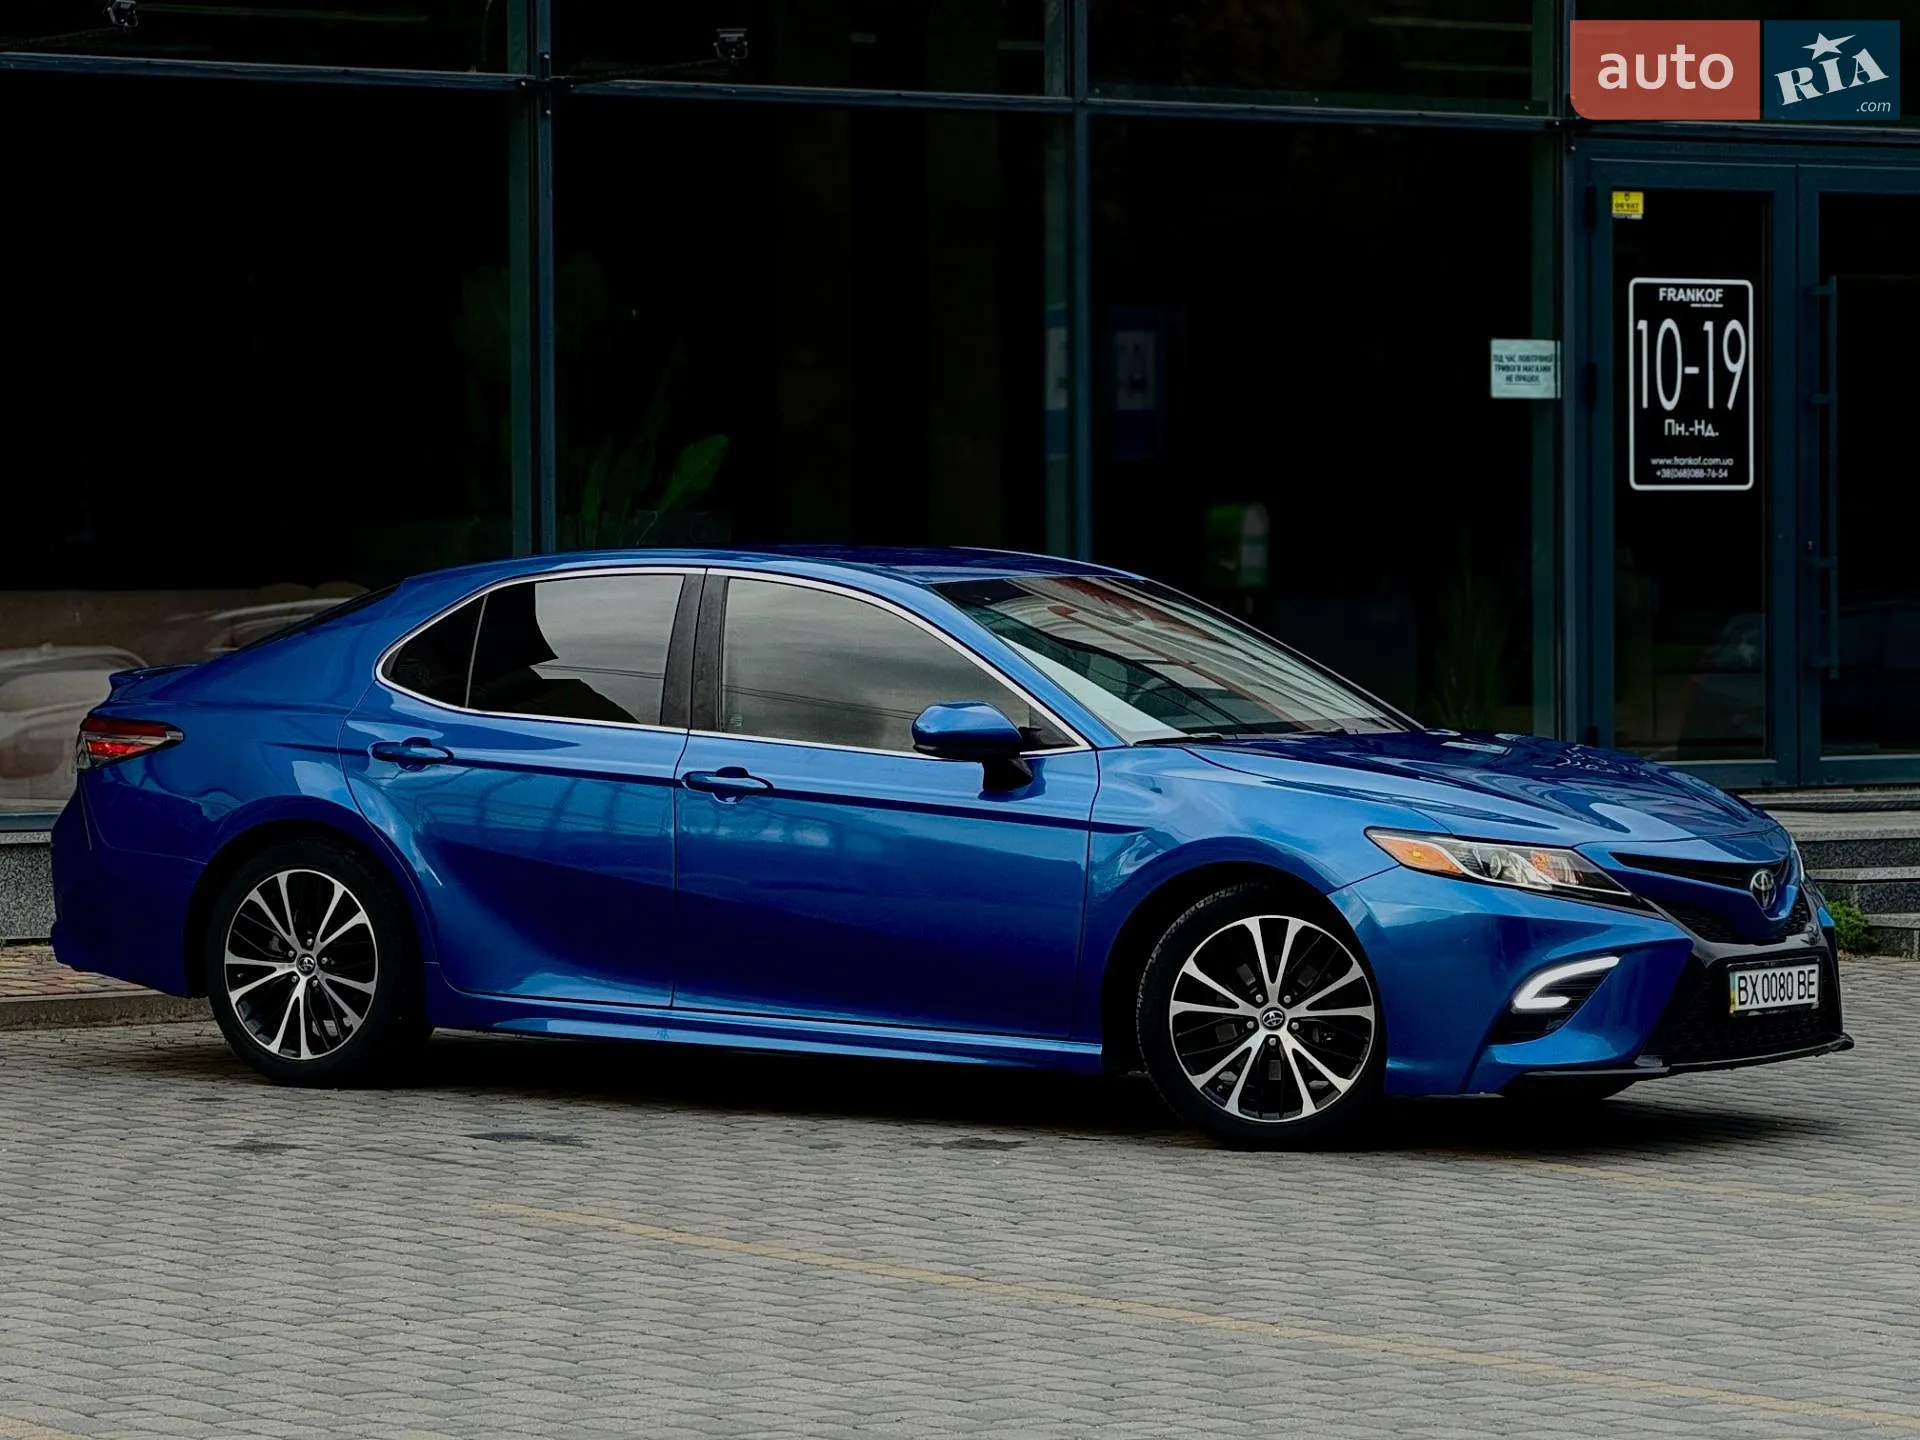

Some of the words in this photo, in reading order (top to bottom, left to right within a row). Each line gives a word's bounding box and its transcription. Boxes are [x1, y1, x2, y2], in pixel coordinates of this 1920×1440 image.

[1659, 287, 1724, 302] FRANKOF
[1637, 318, 1746, 411] 10-19
[1664, 418, 1719, 437] Пн.-Нд.
[1650, 456, 1734, 467] www.frankof.com.ua
[1738, 974, 1759, 1006] BX
[1761, 971, 1794, 1003] 0080
[1797, 969, 1816, 1000] BE
